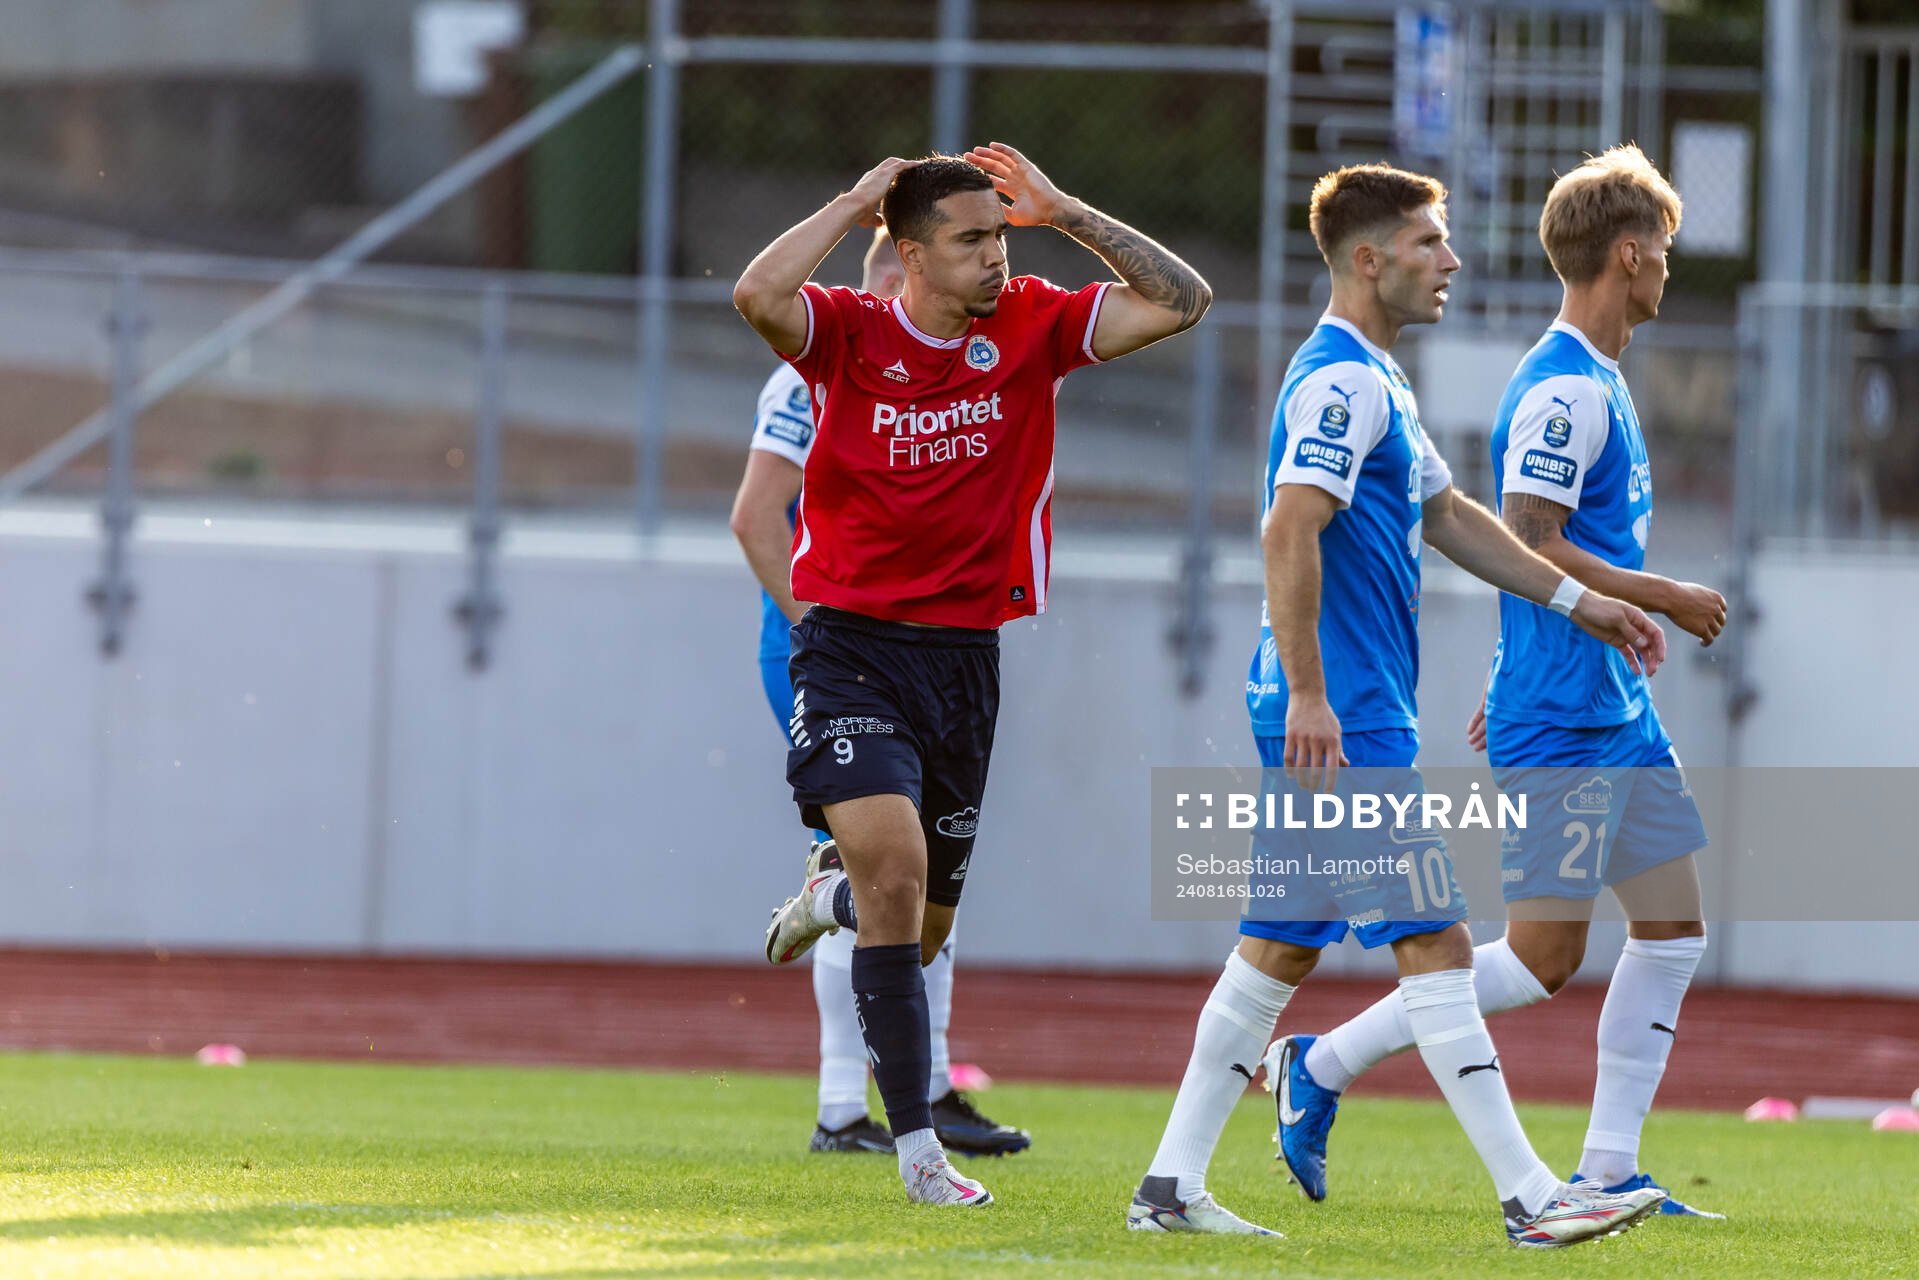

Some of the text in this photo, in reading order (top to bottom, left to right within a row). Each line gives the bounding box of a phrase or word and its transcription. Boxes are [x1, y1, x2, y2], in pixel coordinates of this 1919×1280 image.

[882, 370, 911, 384] SELECT
[872, 392, 1003, 436] Prioritet
[889, 433, 988, 467] Finans
[1300, 443, 1353, 468] UNIBET
[1525, 453, 1575, 477] UNIBET
[821, 723, 894, 739] WELLNESS
[833, 737, 854, 765] 9
[1558, 821, 1607, 879] 21
[1399, 847, 1451, 913] 10
